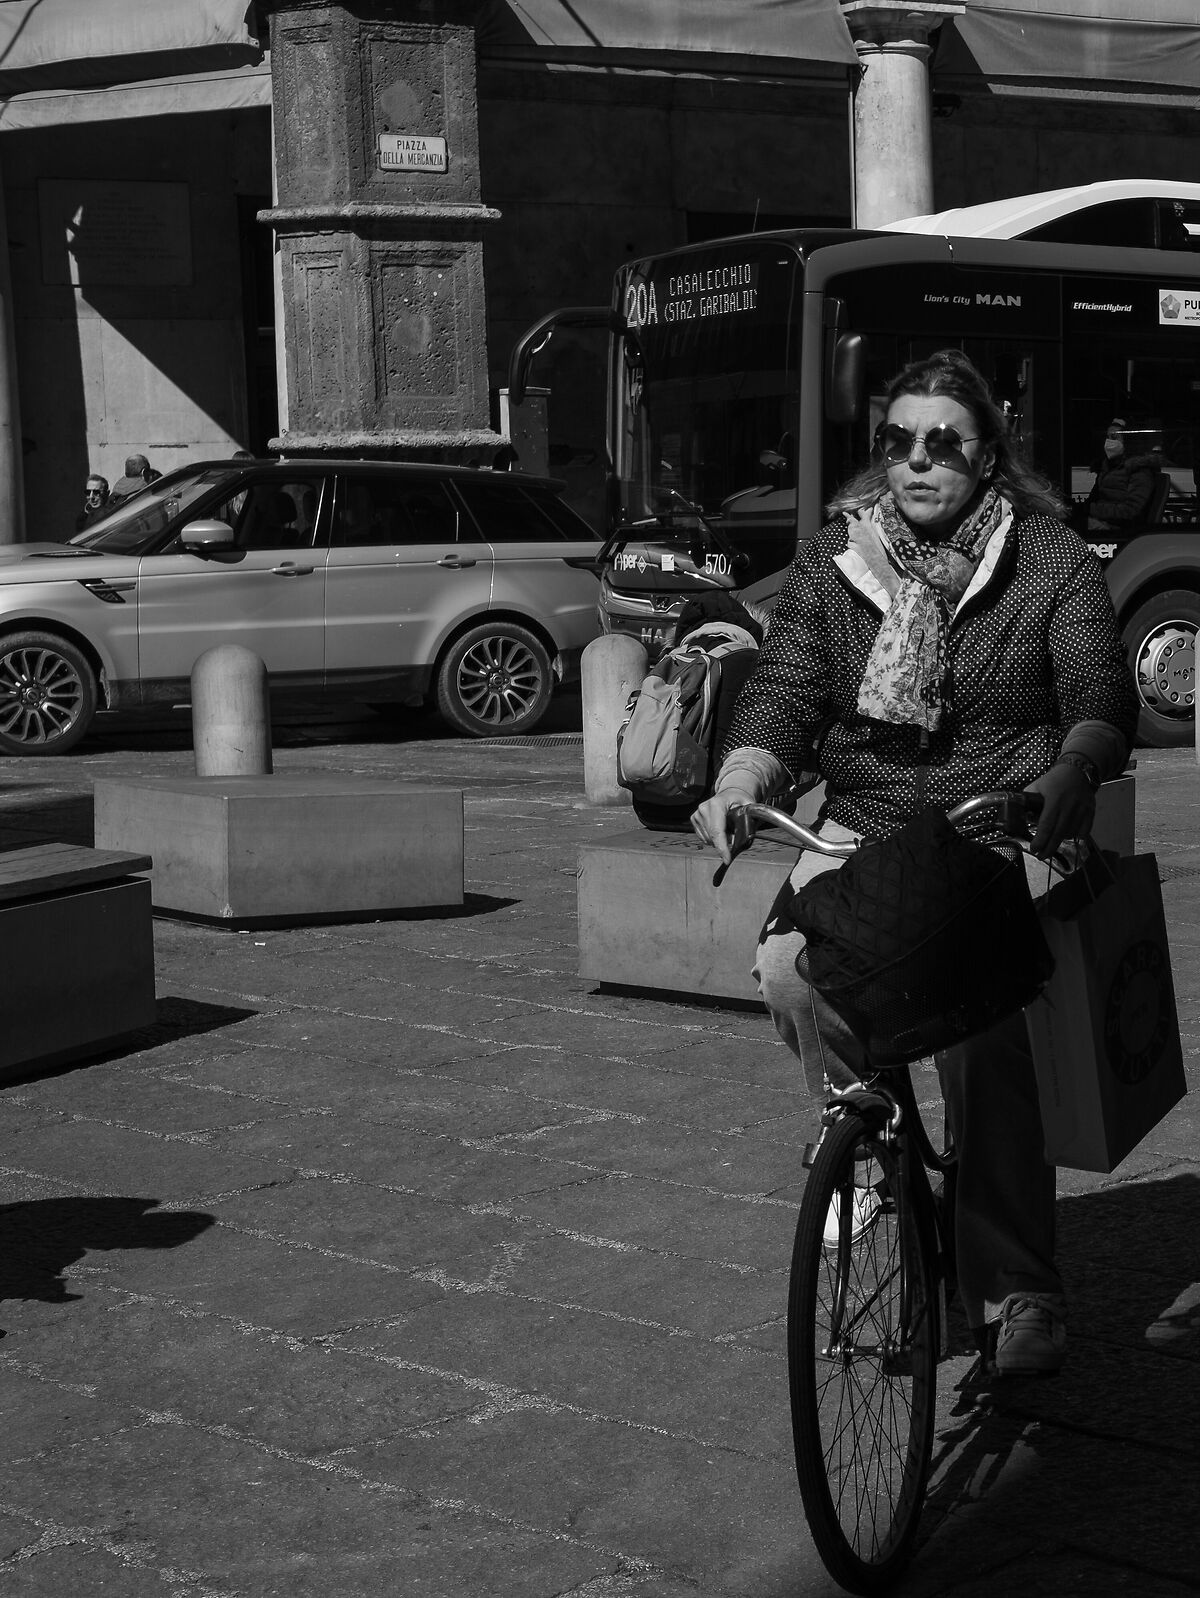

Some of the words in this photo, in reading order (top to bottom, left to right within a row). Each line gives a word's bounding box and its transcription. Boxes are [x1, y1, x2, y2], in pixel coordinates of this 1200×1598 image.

[397, 140, 427, 151] PIAZZA
[383, 152, 404, 164] DELLA
[407, 153, 443, 166] MERCANZIA
[669, 263, 751, 297] CASALECCHIO
[626, 280, 658, 328] 20A
[924, 294, 950, 303] Lion's
[952, 295, 971, 305] City
[975, 293, 1022, 307] MAN
[1072, 301, 1133, 313] EfficientHybrid
